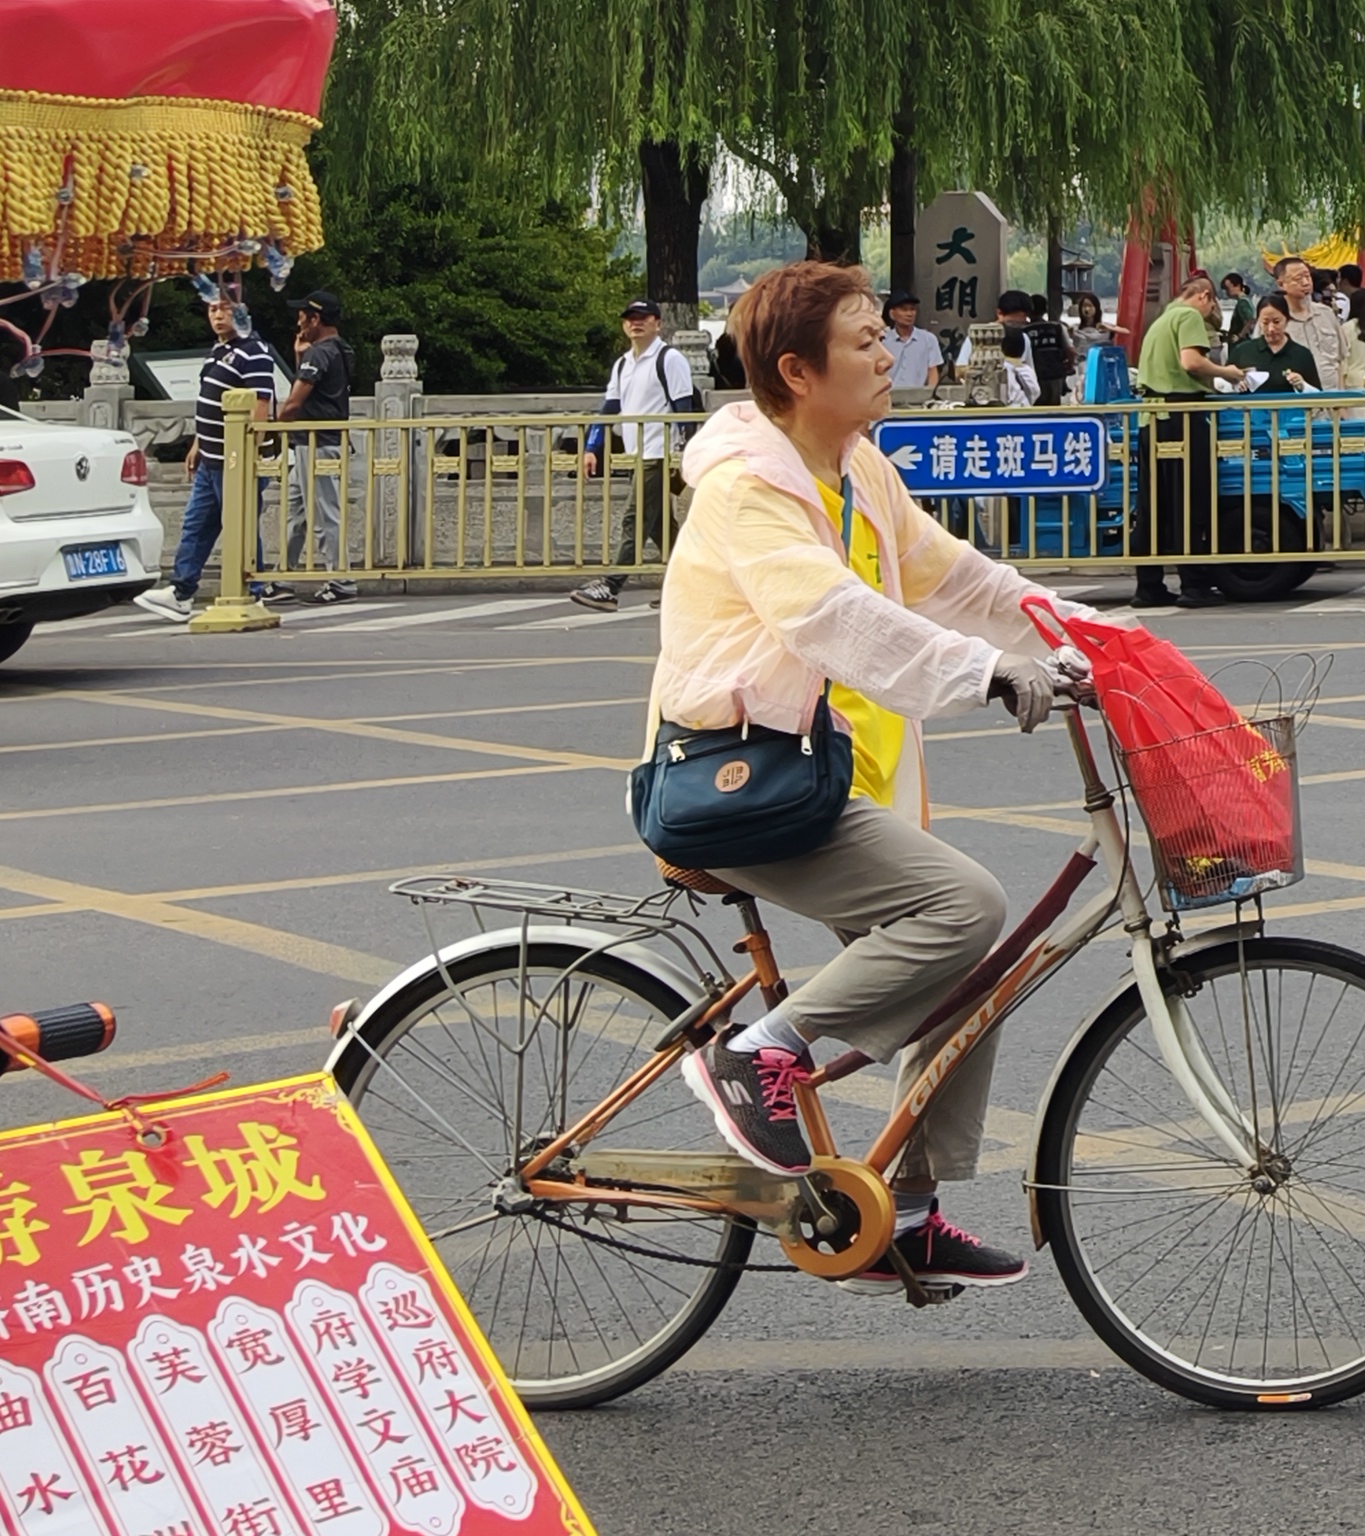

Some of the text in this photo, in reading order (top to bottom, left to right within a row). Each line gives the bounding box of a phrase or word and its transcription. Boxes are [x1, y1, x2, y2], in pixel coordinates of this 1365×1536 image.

[929, 431, 1093, 481] 请走斑马线
[910, 987, 1001, 1117] GIANT
[0, 1211, 387, 1340] 南历史泉水文化
[224, 1327, 363, 1525] 宽厚里
[308, 1308, 440, 1508] 府学文庙
[377, 1289, 519, 1484] 巡府大院
